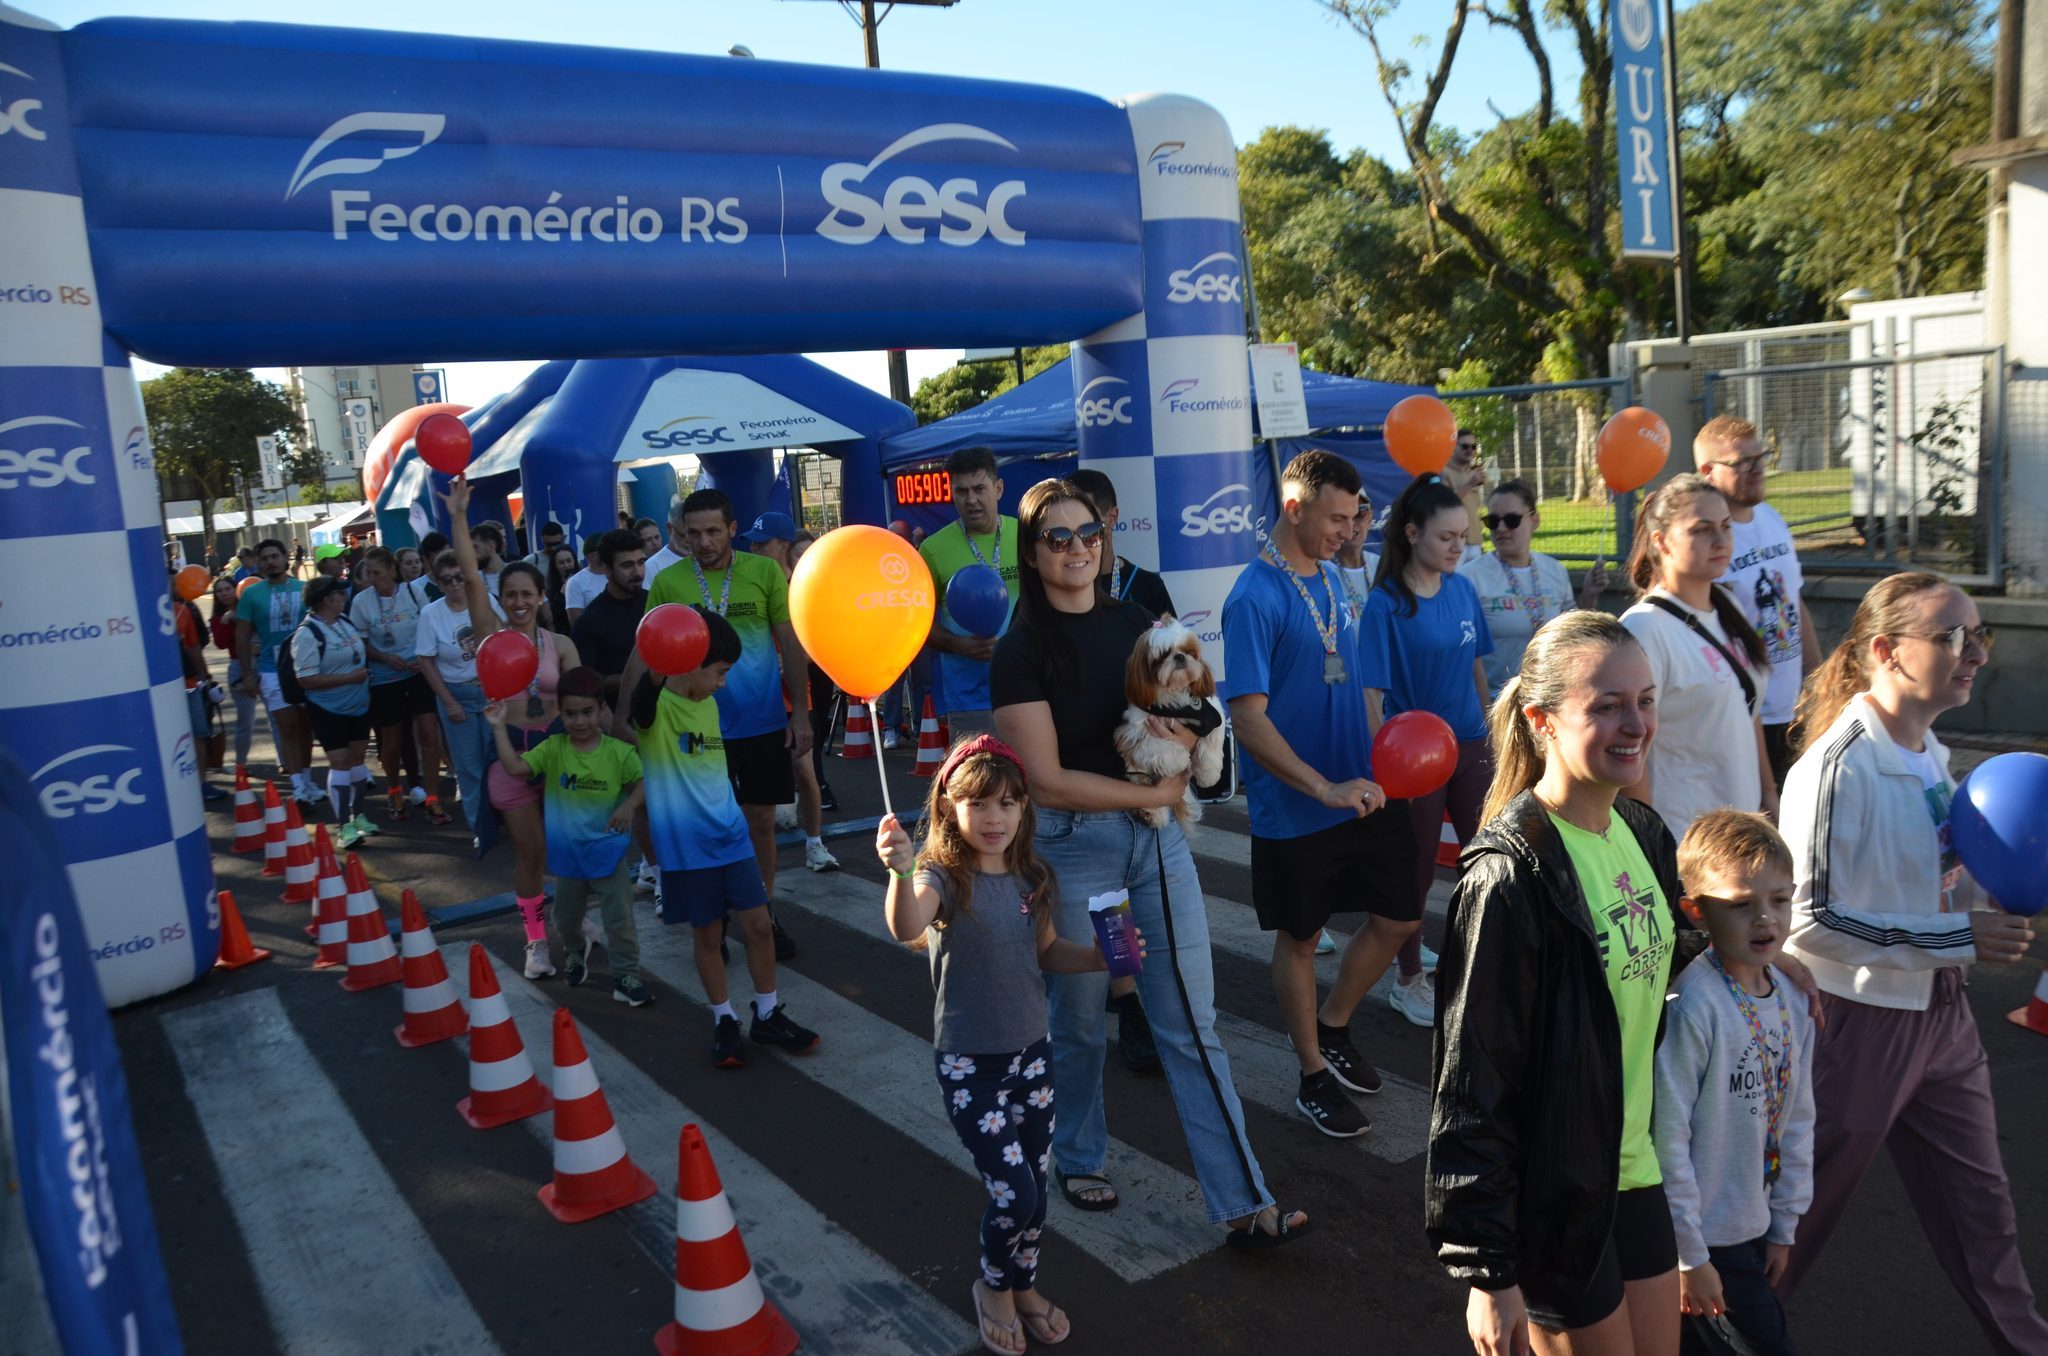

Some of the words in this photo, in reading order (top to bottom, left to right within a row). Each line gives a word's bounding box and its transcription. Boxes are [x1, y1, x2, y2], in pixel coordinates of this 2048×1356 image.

[1624, 63, 1660, 246] URI
[331, 190, 663, 243] Fecomércio
[682, 196, 749, 245] RS
[59, 286, 91, 306] RS
[740, 416, 816, 431] Fecomércio
[0, 446, 96, 489] esc
[1132, 518, 1152, 531] RS
[855, 589, 931, 612] CRESOL
[0, 621, 101, 648] omércio
[107, 617, 135, 636] RS
[39, 767, 146, 819] esc
[159, 923, 186, 945] RS
